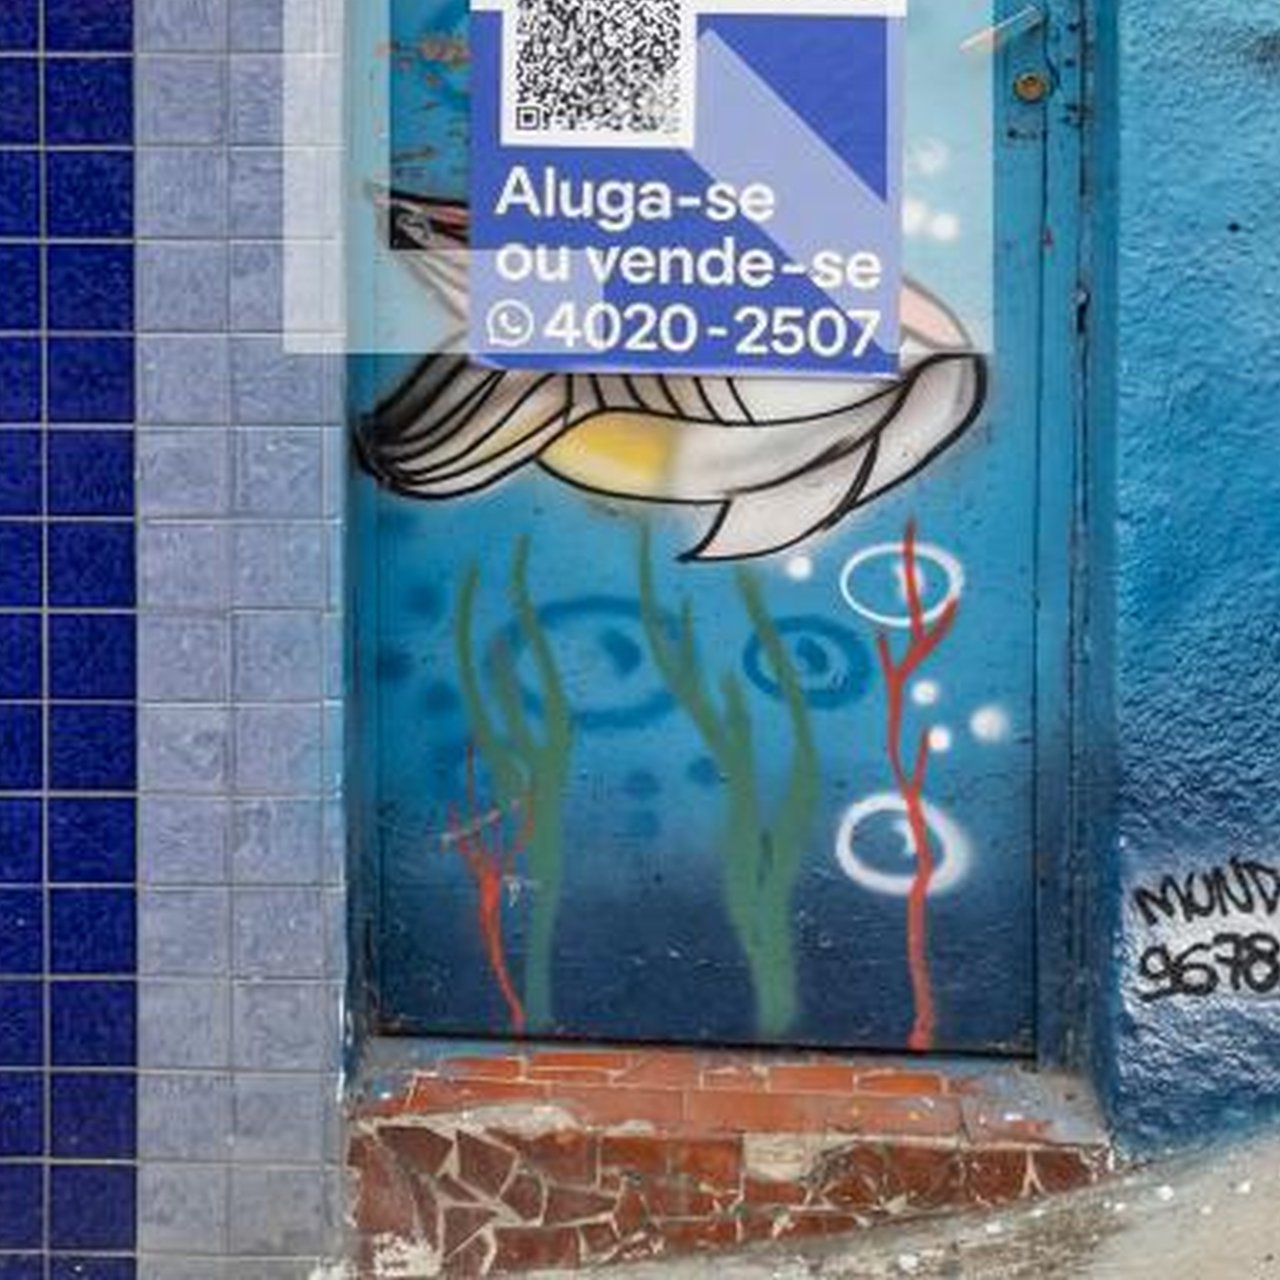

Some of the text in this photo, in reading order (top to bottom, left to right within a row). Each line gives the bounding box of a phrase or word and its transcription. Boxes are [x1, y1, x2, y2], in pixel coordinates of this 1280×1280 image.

[495, 166, 775, 231] Aluga-se
[495, 237, 882, 288] ou vende-se
[544, 302, 881, 357] 4020-2507
